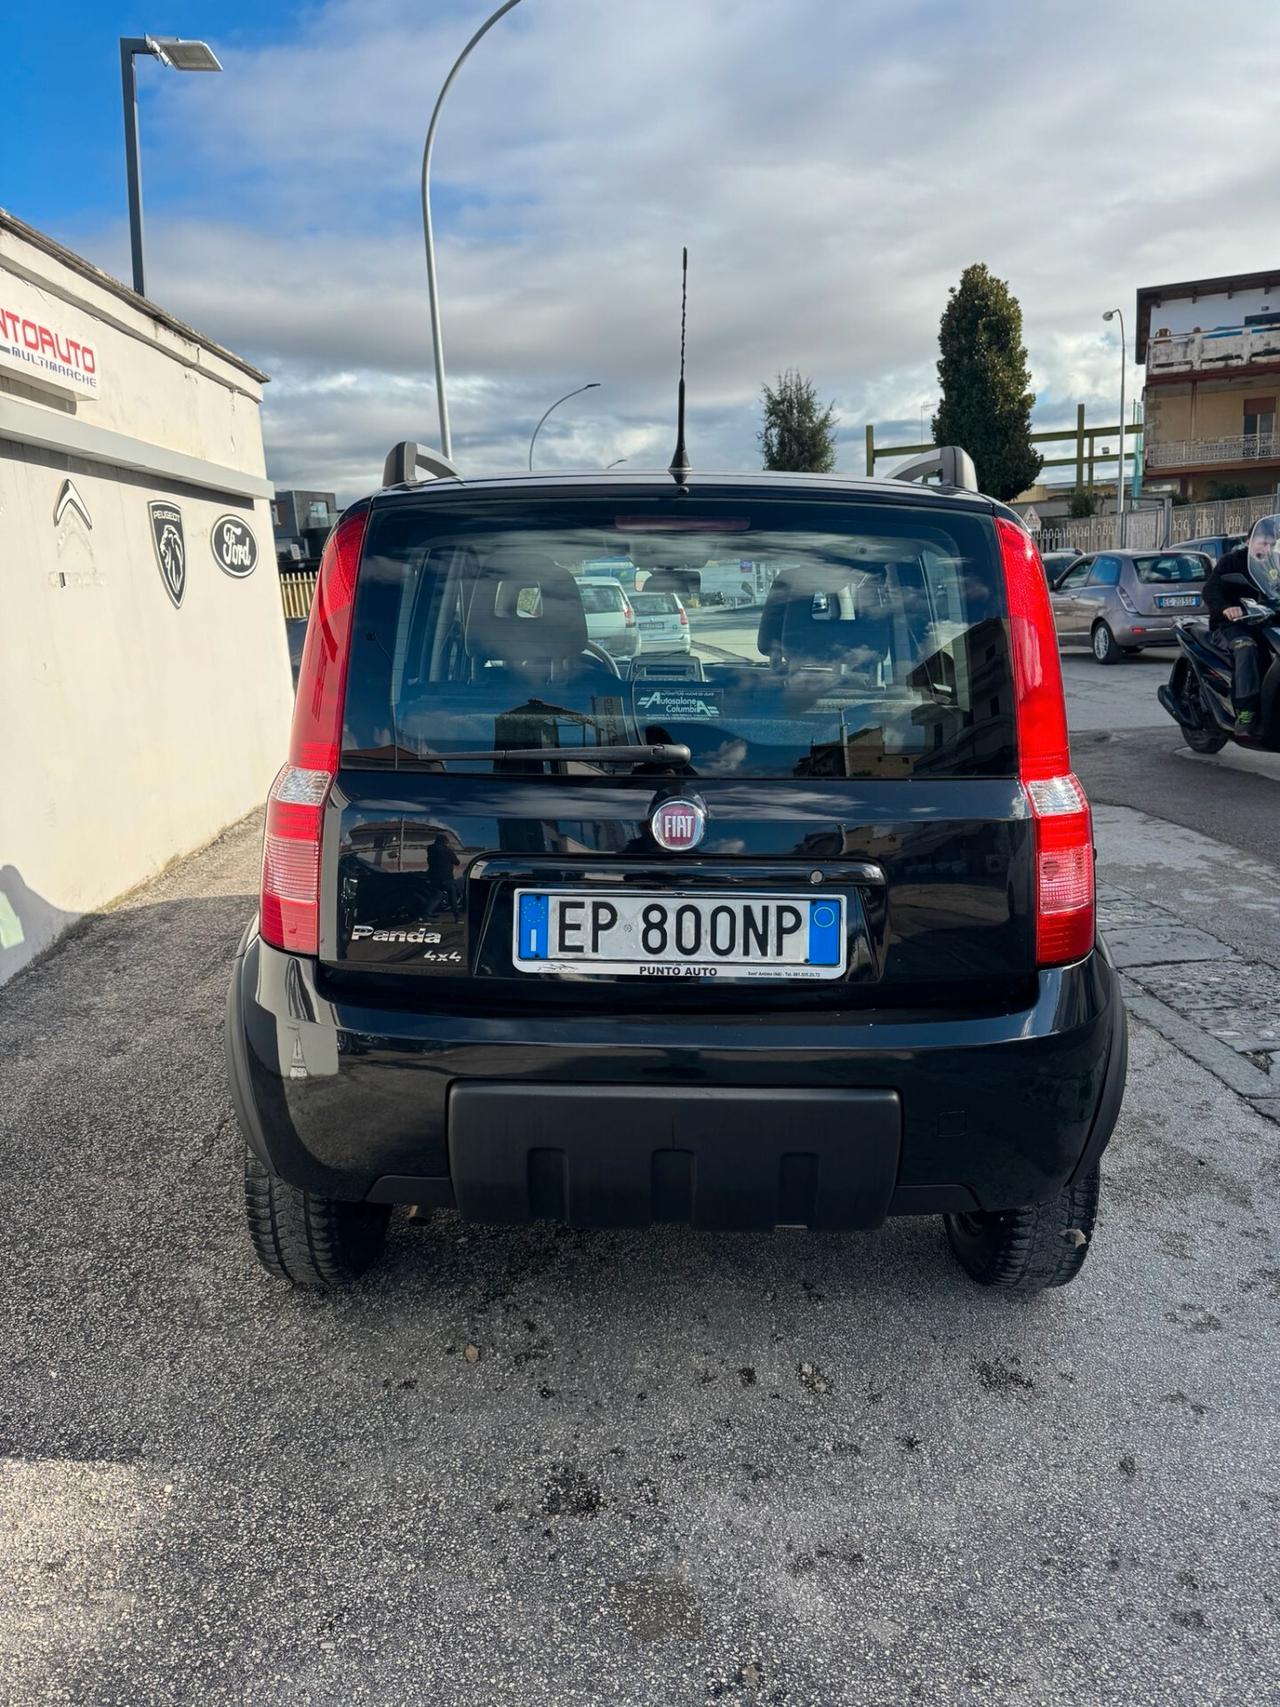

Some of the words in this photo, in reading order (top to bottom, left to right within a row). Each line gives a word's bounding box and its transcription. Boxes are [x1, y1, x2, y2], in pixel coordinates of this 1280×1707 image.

[11, 346, 96, 388] MULTIMARCHE
[153, 510, 180, 523] PEUGEOT
[223, 523, 251, 566] Ford
[644, 692, 696, 708] Autosalone
[664, 815, 694, 838] FIAT
[351, 925, 441, 944] Panda
[558, 900, 618, 953] EP
[641, 903, 802, 957] 800NP
[424, 950, 462, 962] 4x4
[639, 965, 681, 977] PUNTO
[684, 966, 718, 977] AUTO
